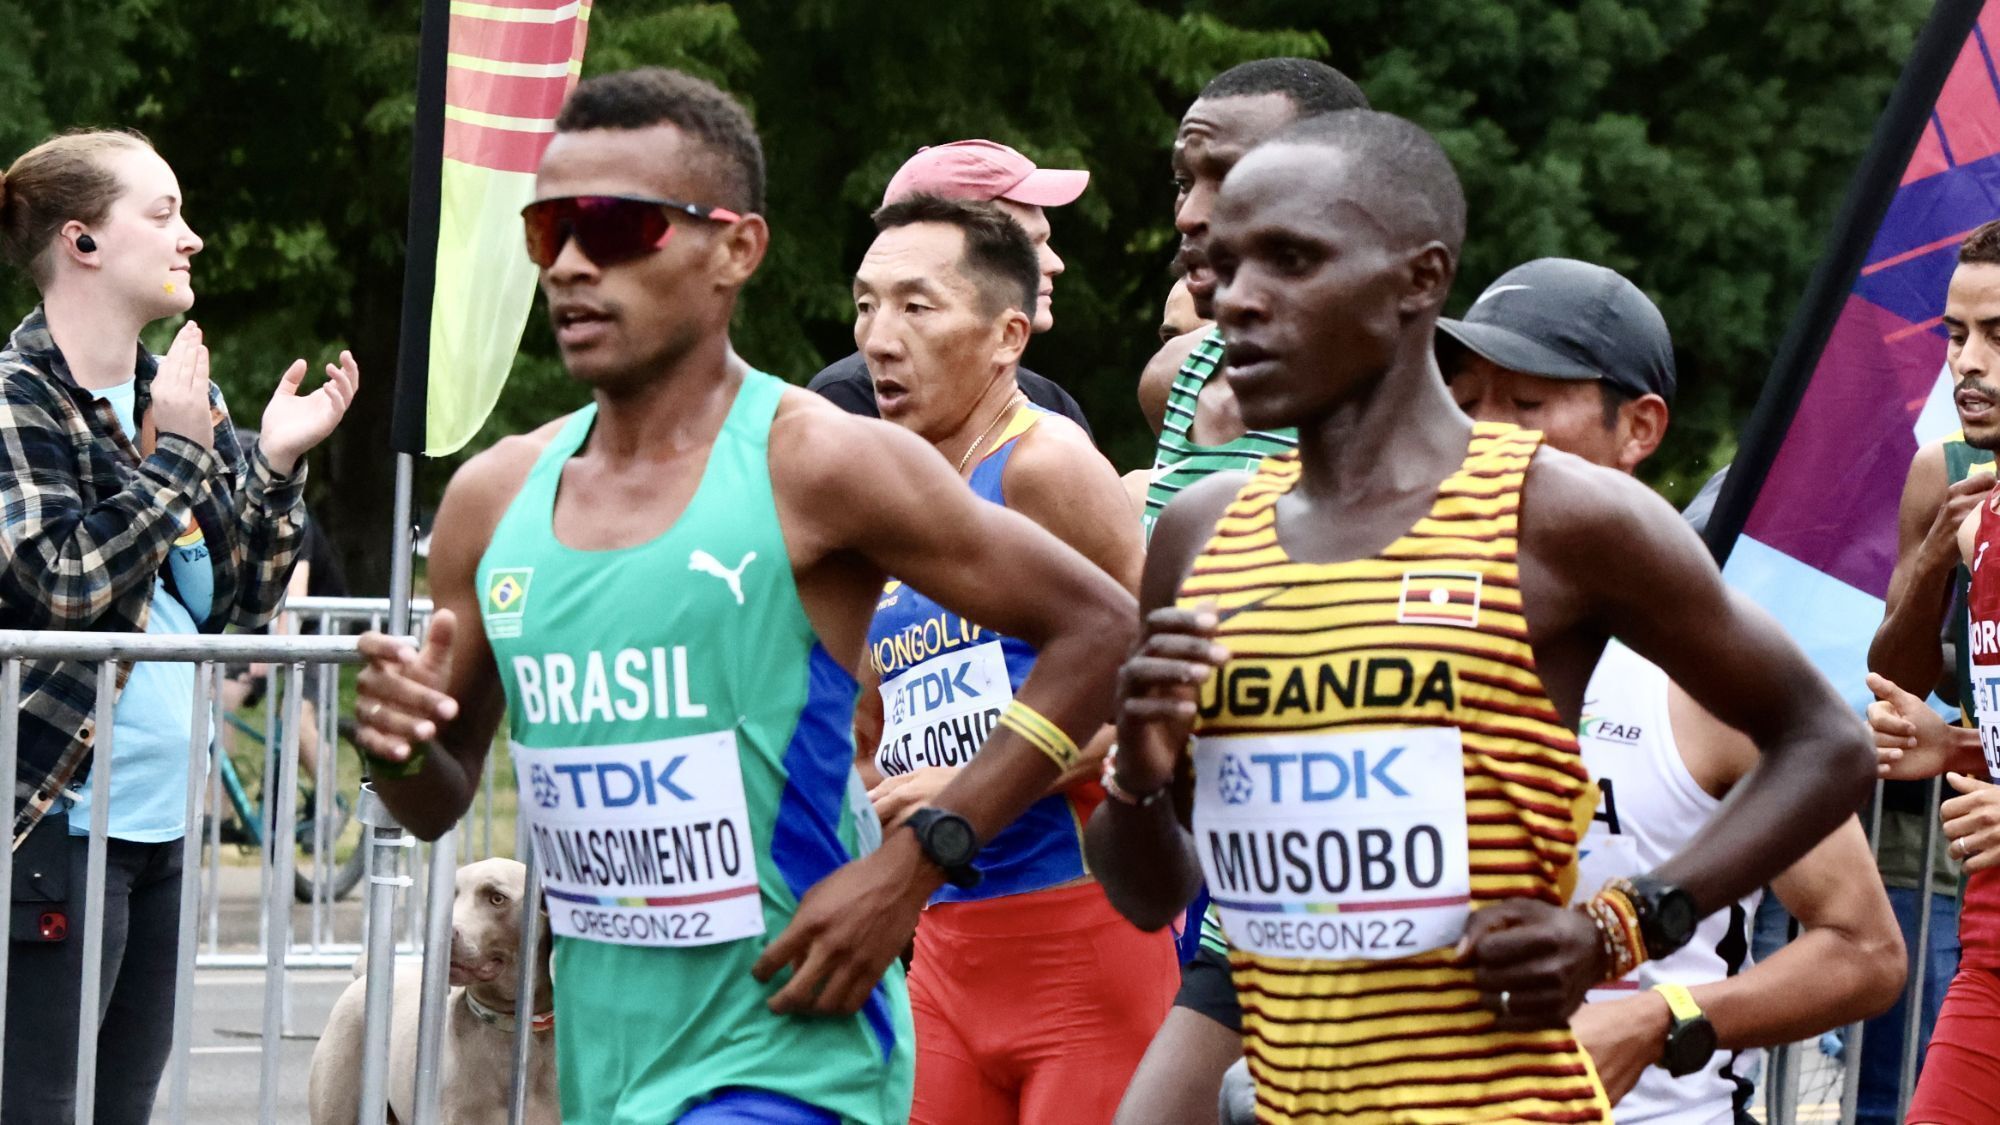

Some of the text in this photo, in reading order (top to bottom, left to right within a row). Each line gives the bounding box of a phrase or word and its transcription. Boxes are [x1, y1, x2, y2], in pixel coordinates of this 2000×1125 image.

[513, 646, 707, 725] BRASIL
[906, 661, 981, 717] TDK
[1199, 657, 1456, 719] UGANDA
[1598, 721, 1642, 740] FAB
[554, 755, 697, 808] TDK
[1250, 746, 1413, 803] TDK
[556, 818, 742, 886] NASCIMENTO
[1209, 824, 1444, 894] MUSOBO
[570, 911, 715, 940] OREGON22
[1245, 919, 1418, 952] OREGON22
